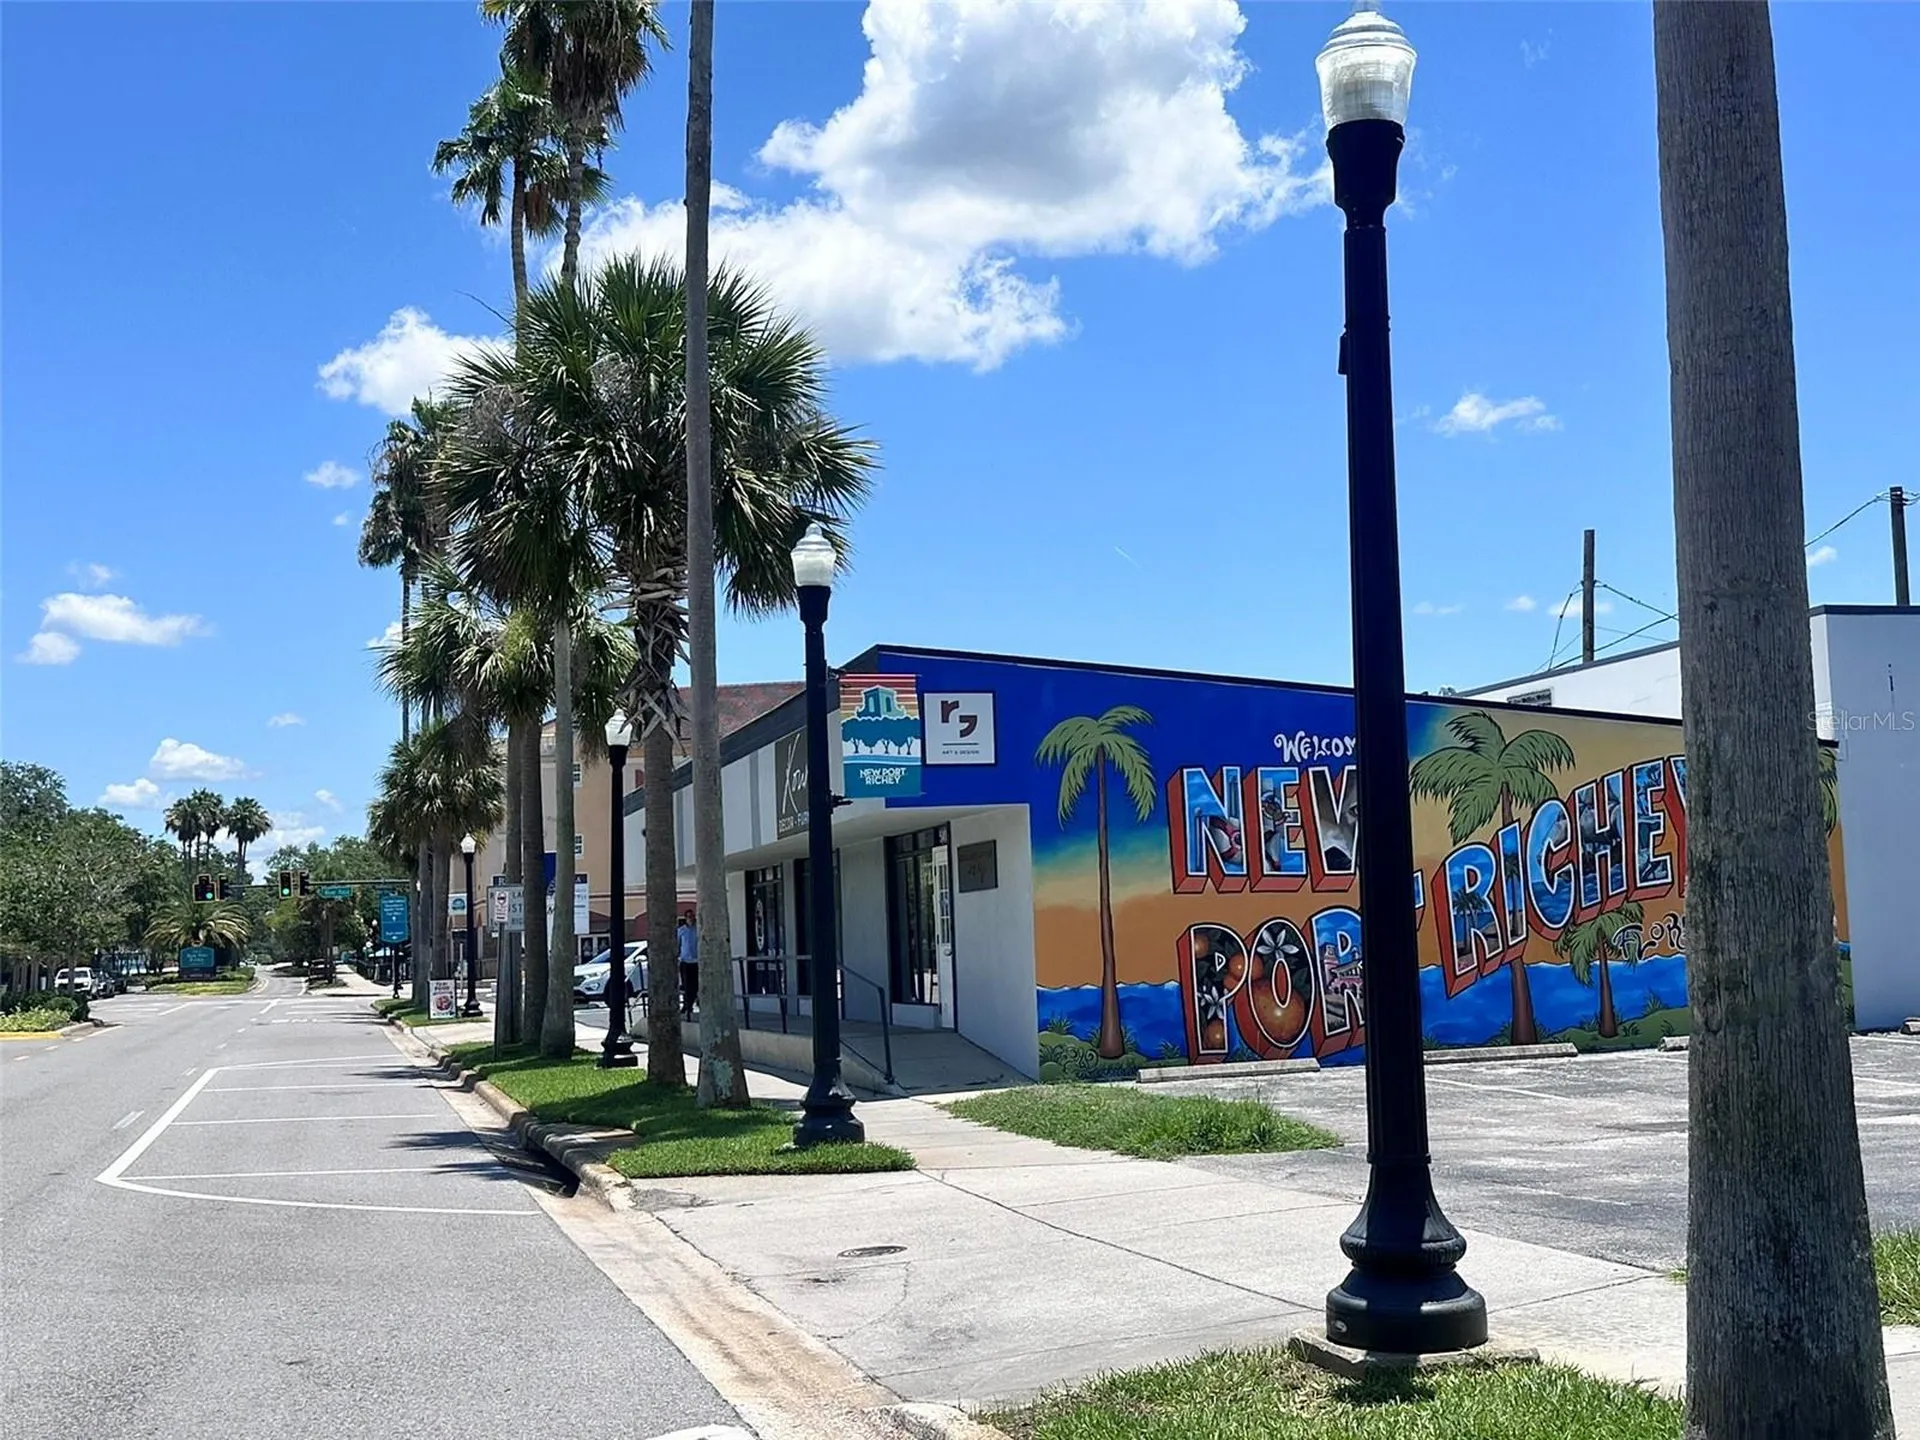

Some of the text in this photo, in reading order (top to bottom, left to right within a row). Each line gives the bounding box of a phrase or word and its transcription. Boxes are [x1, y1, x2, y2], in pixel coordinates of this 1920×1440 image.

[1274, 730, 1357, 763] WELCOM
[859, 768, 906, 778] NEW PORT
[865, 775, 900, 785] RICHEY
[1611, 911, 1687, 961] FLOR
